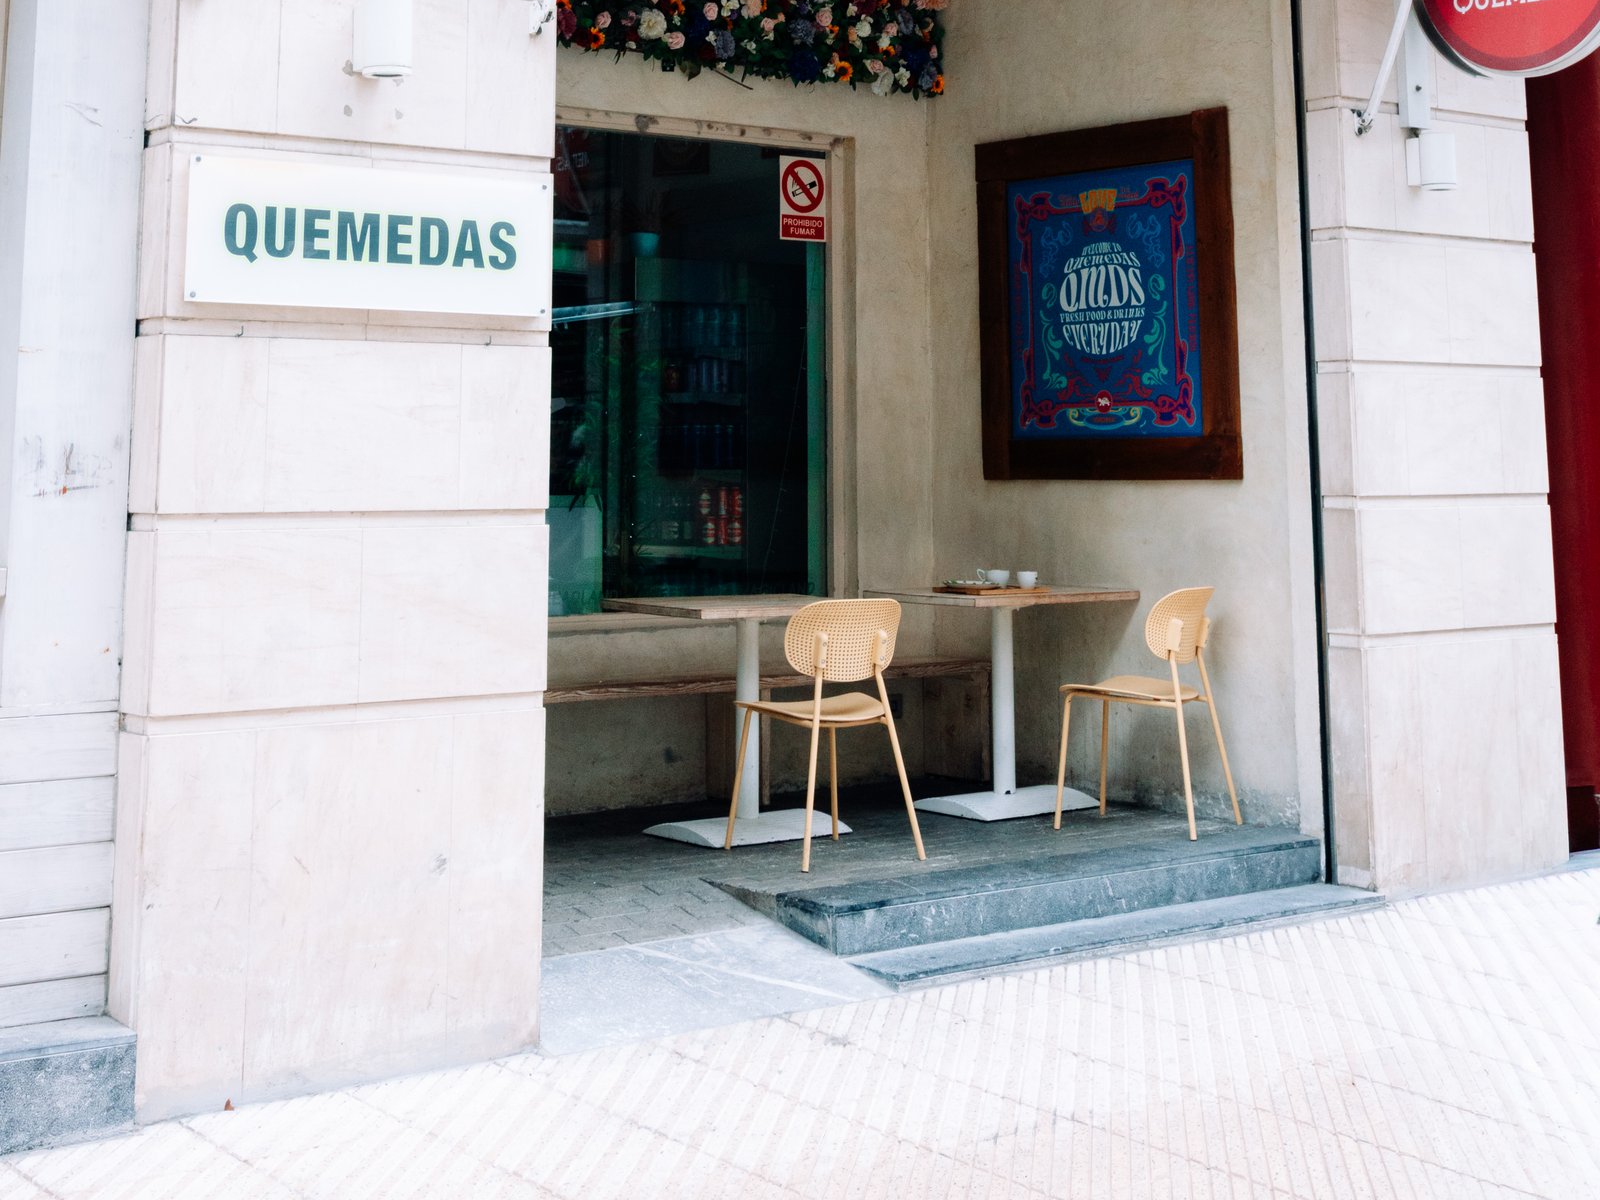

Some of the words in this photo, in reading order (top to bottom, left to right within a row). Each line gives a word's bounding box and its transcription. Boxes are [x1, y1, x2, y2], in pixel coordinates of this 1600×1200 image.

[783, 217, 823, 228] PROHIBIDO
[223, 202, 518, 271] QUEMEDAS
[790, 227, 816, 236] FUMAR
[1063, 251, 1141, 274] QUEMEDAS
[1059, 311, 1085, 323] FRESH
[1085, 310, 1106, 321] FOOD
[1106, 310, 1113, 320] &
[1113, 307, 1146, 320] DRINKS
